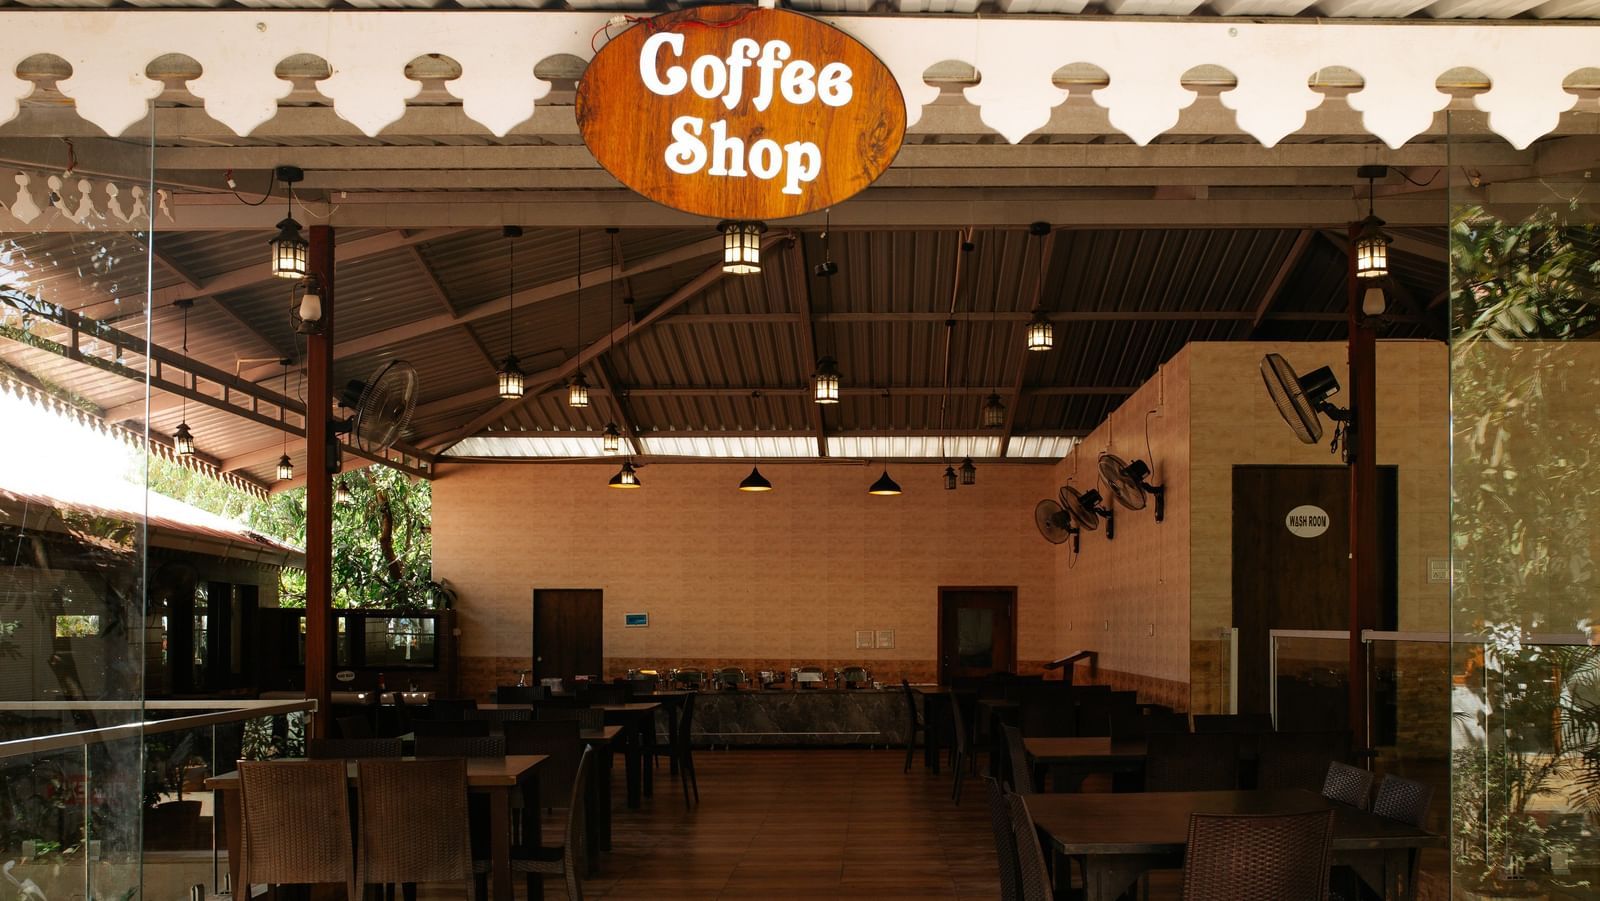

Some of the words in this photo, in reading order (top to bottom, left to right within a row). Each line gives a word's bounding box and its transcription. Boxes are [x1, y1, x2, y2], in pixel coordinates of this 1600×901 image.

[639, 32, 853, 112] Coffee
[664, 115, 821, 195] Shop
[1289, 515, 1307, 527] WASH
[1308, 515, 1327, 527] ROOM
